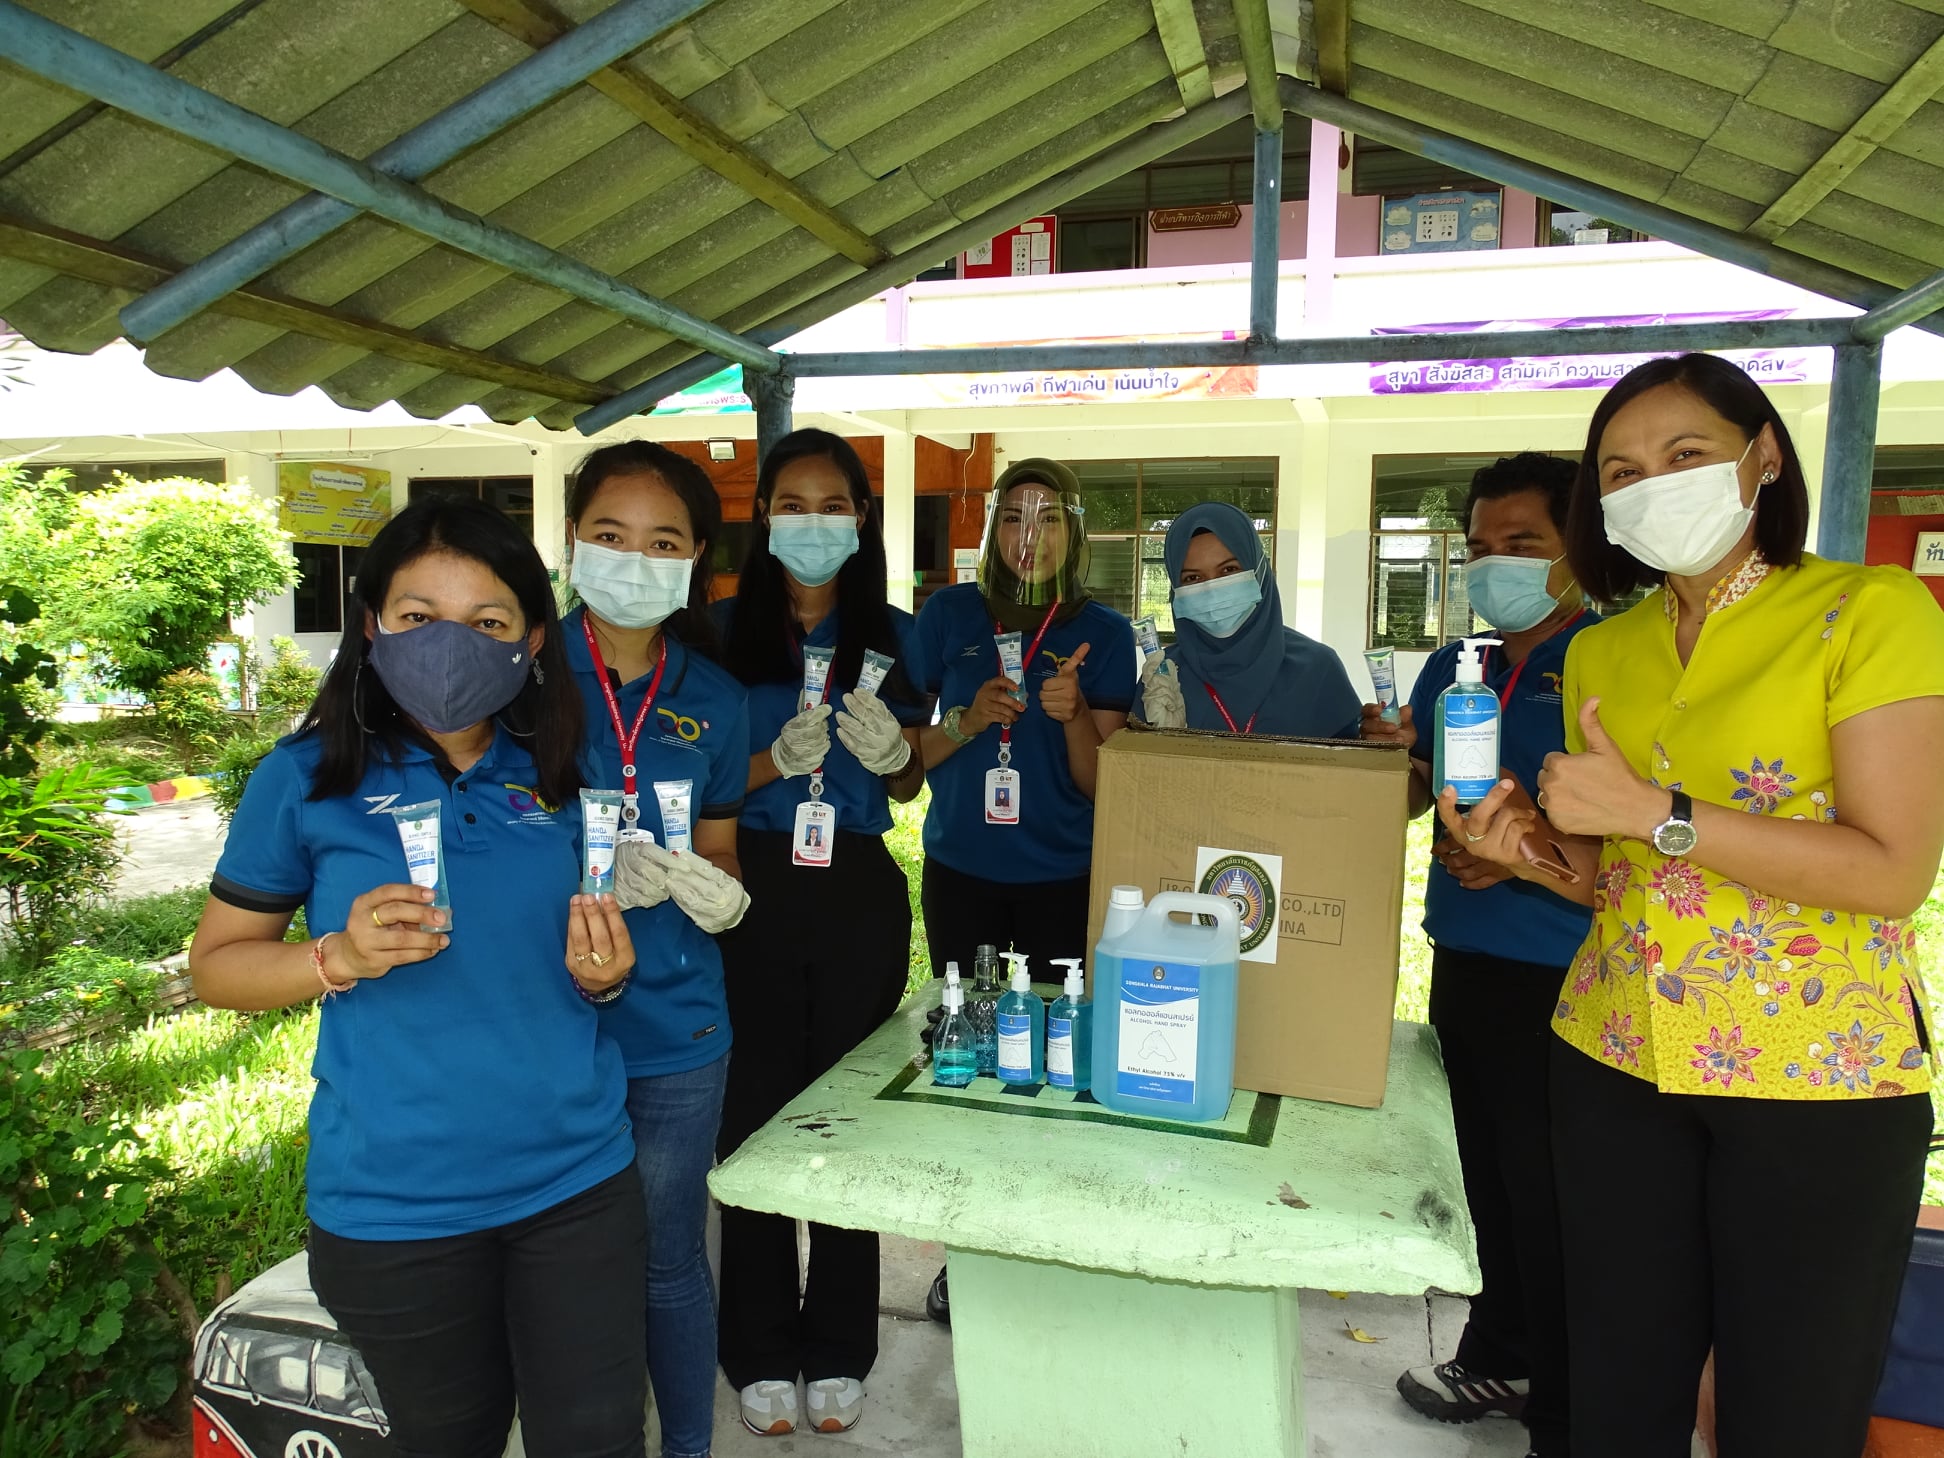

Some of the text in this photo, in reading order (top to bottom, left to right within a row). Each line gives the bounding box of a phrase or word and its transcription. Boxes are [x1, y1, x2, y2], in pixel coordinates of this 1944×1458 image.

[969, 377, 1034, 400] สุขภาพดี
[1279, 919, 1306, 936] INA
